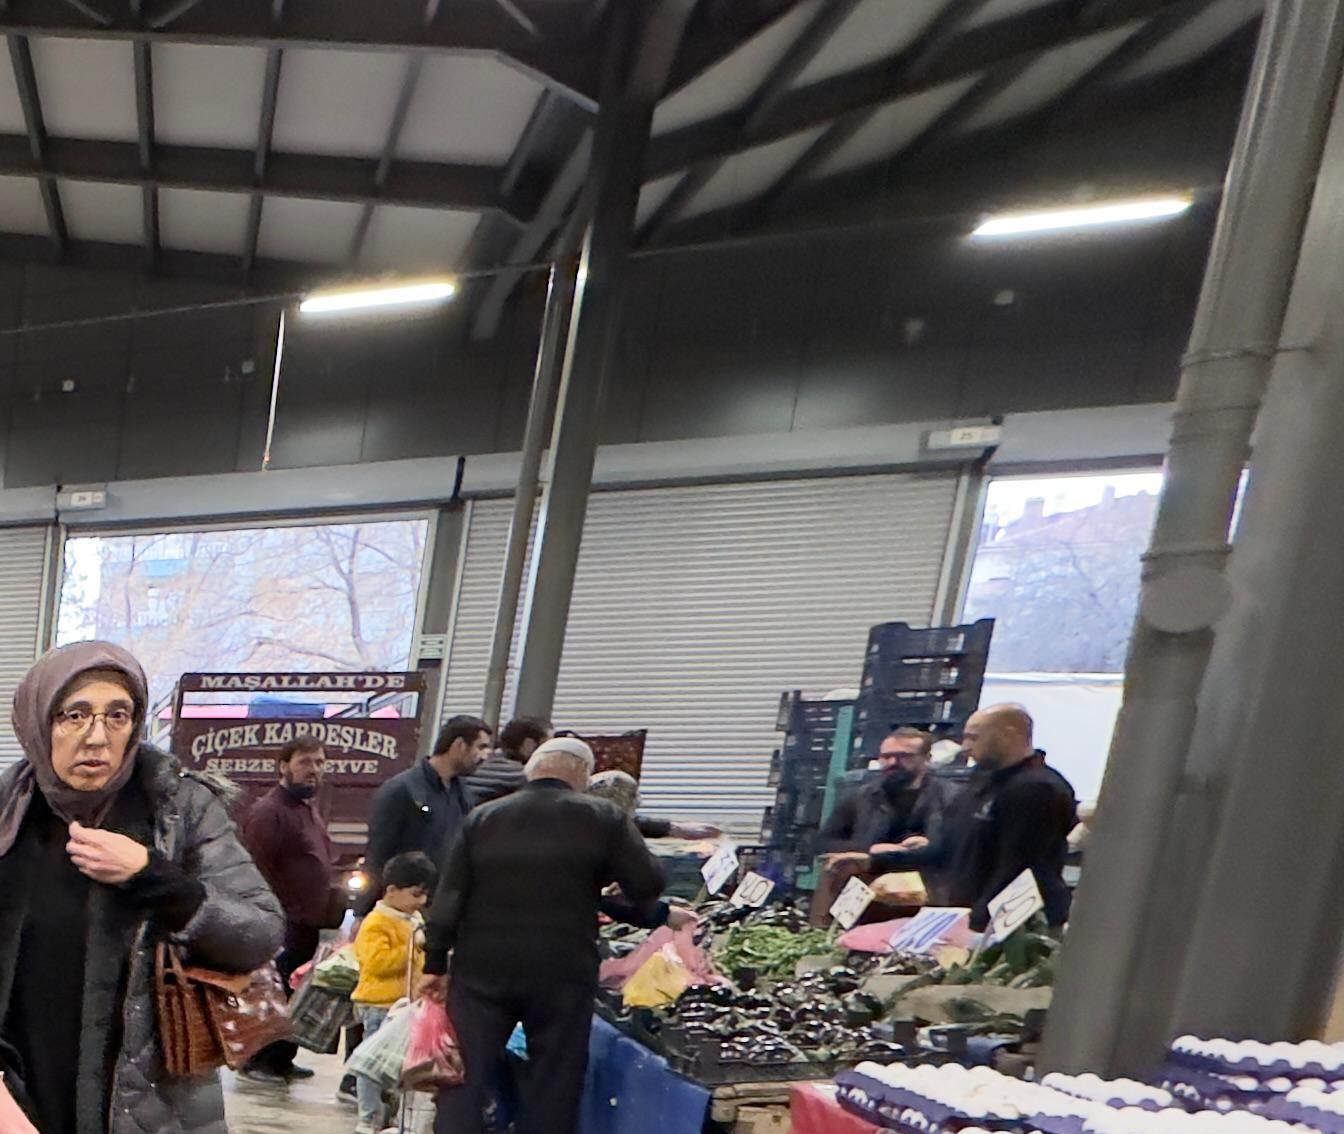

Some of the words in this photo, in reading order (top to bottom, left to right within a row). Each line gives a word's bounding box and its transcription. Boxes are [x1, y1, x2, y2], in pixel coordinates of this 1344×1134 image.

[200, 675, 405, 690] MAŞALLAH'DE
[191, 724, 261, 762] ÇİÇEK
[263, 722, 399, 759] KARDEŞLER
[206, 758, 276, 773] SEBZE
[322, 759, 379, 774] EYVE
